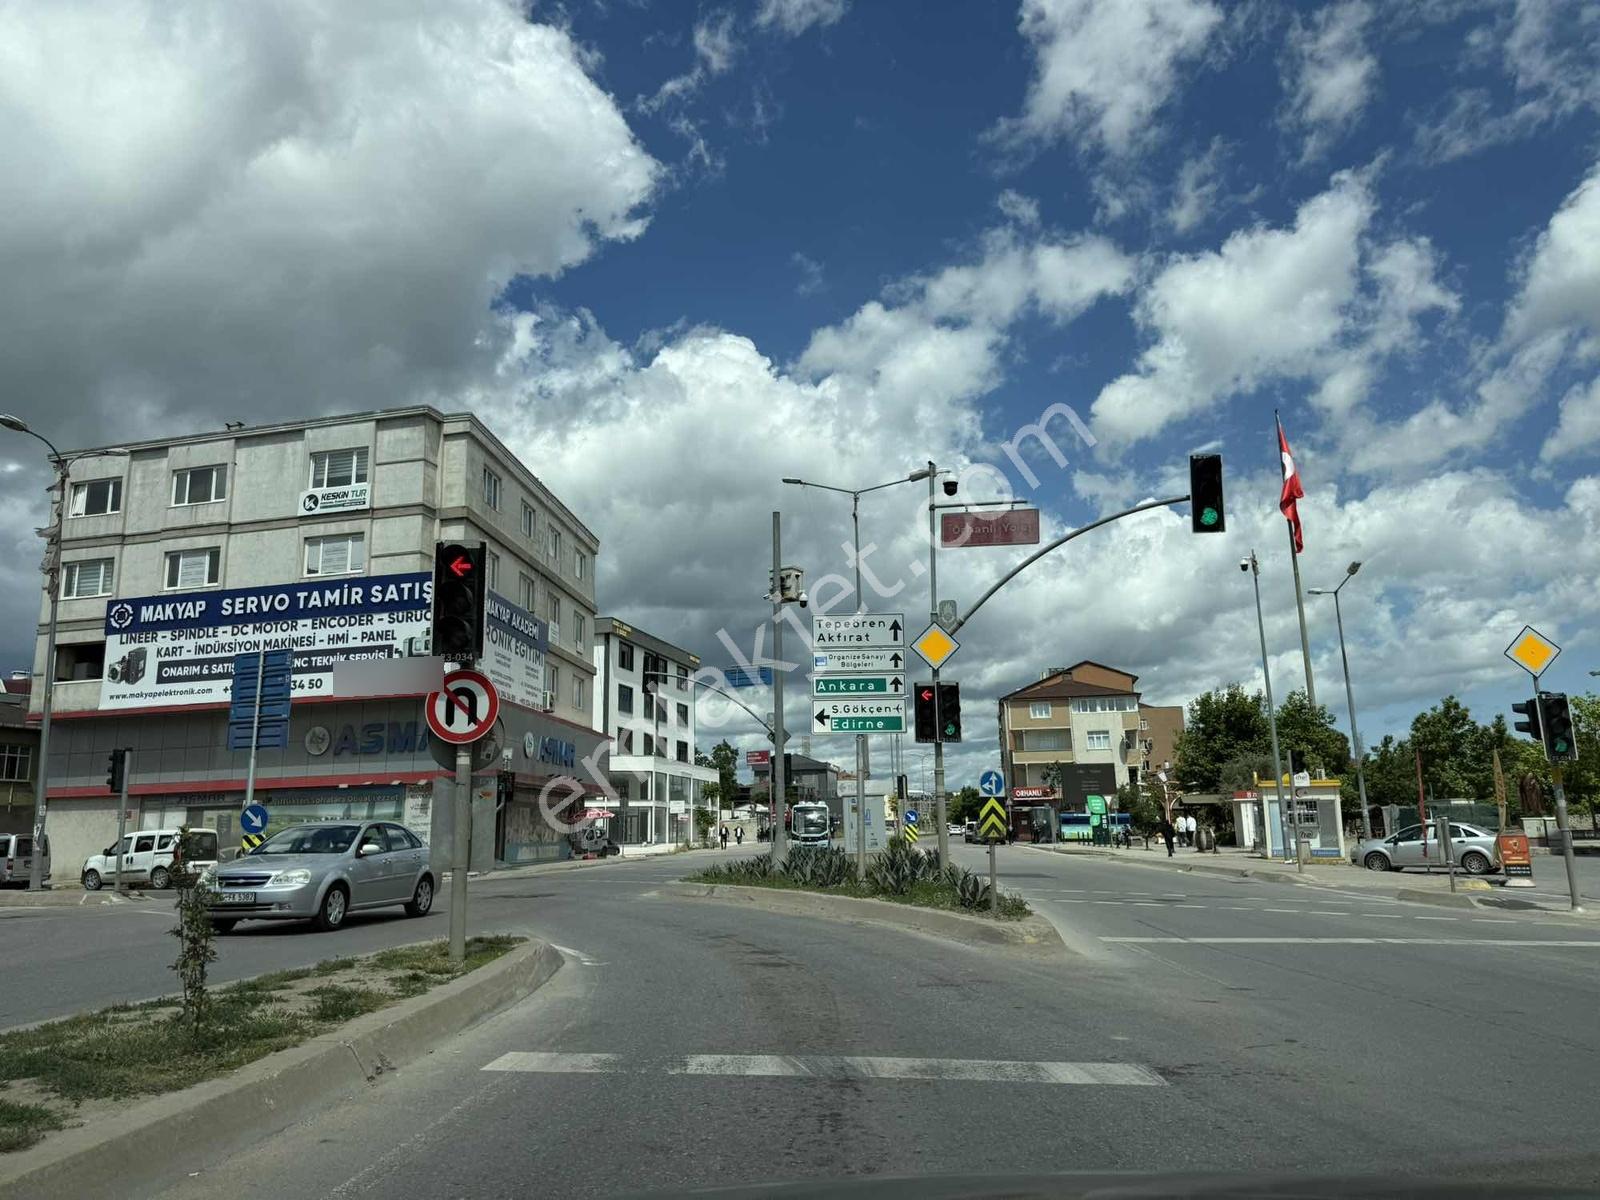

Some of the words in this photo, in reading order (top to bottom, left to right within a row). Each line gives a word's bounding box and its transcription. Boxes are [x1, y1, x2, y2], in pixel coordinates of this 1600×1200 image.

[140, 601, 206, 622] MAKYAP
[221, 594, 290, 616] SERVO
[296, 584, 363, 609] TAMİR
[370, 582, 432, 603] SATIŞ
[170, 626, 218, 642] SPINDLE
[231, 624, 249, 636] DC
[253, 620, 298, 634] MOTOR
[312, 614, 374, 630] ENCODER
[816, 619, 886, 631] Tepeören
[156, 646, 184, 658] KART
[194, 639, 260, 655] İNDÜKSİYON
[263, 632, 316, 650] MAKİNESİ
[328, 630, 349, 645] HMİ
[361, 630, 397, 642] PANEL
[162, 665, 200, 677] ONARIM
[202, 664, 209, 674] &
[109, 688, 212, 700] www.makyapelektronik.com
[308, 678, 323, 689] 50
[817, 681, 875, 691] Ankara
[832, 704, 892, 714] S.Gökçen
[832, 719, 884, 729] Edirne
